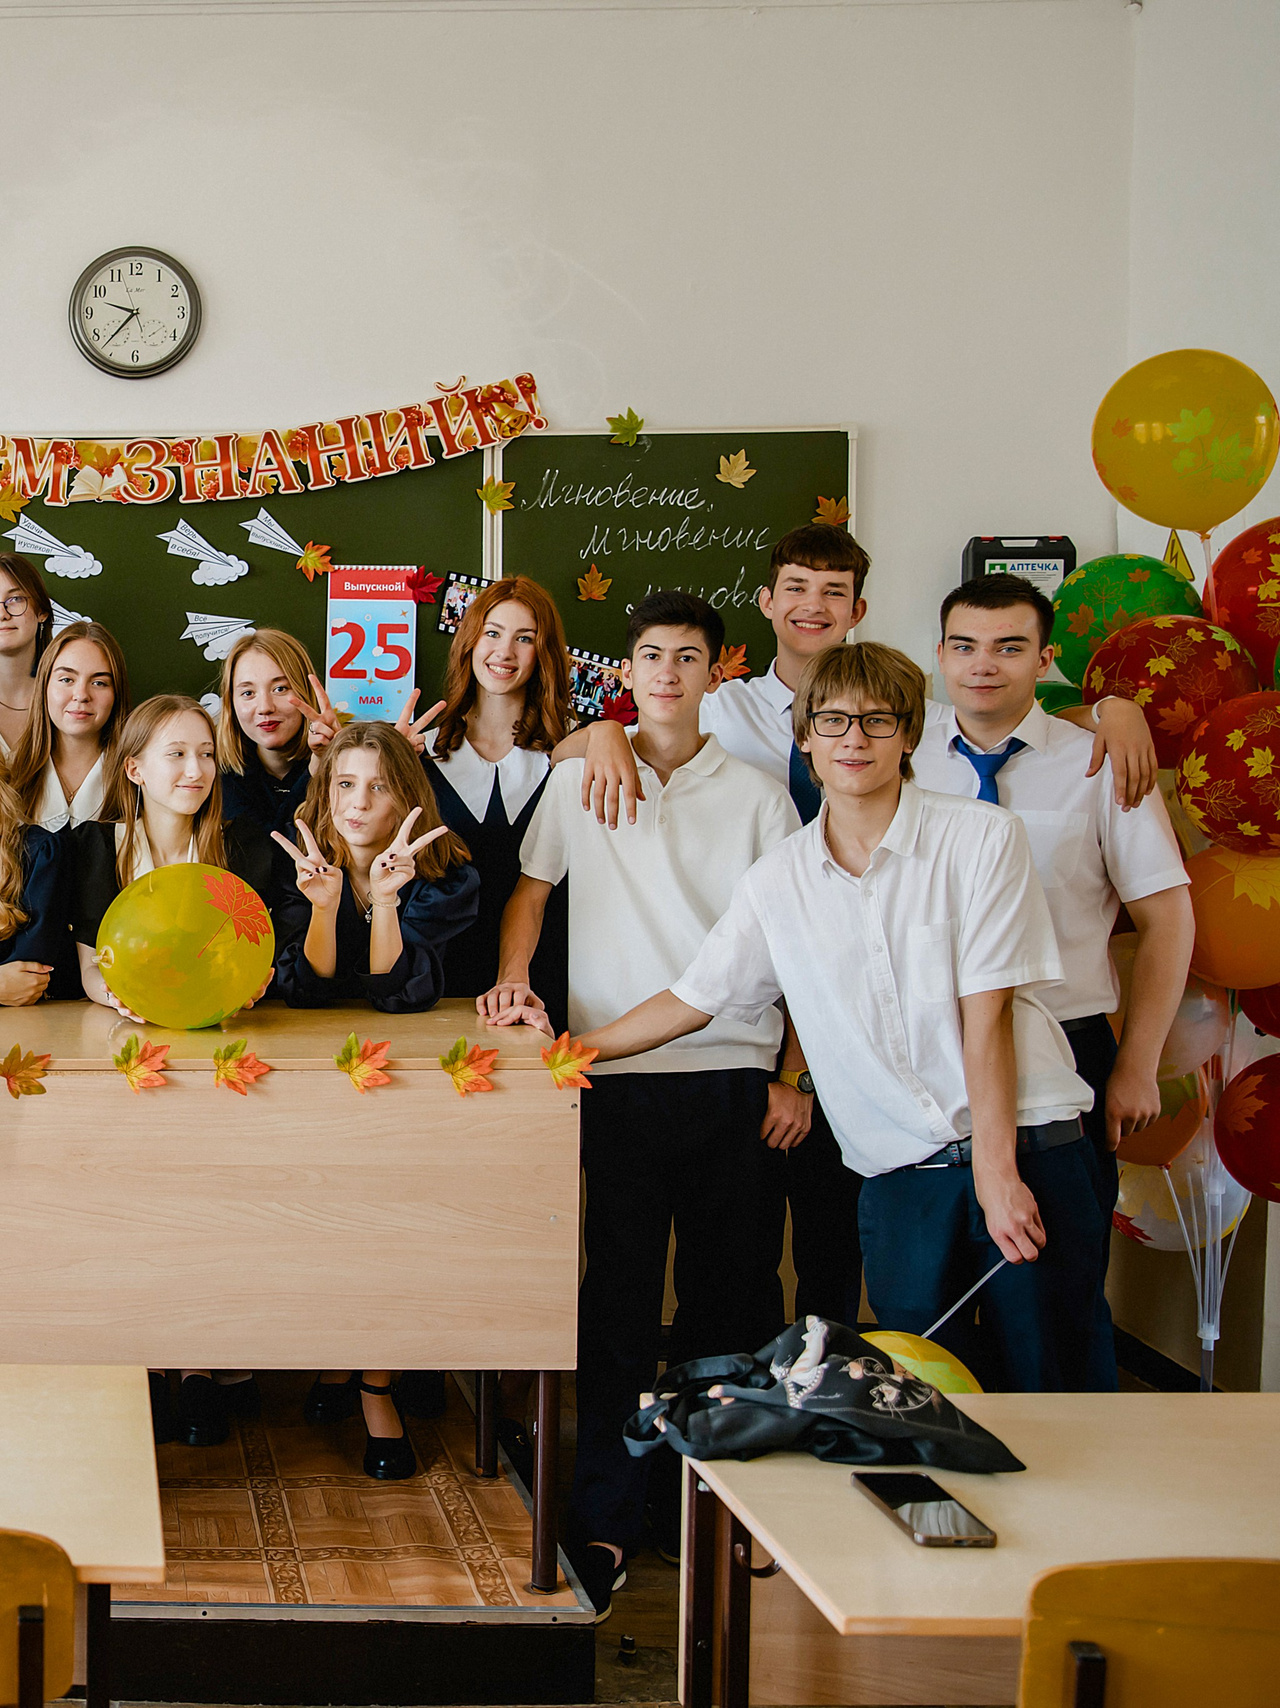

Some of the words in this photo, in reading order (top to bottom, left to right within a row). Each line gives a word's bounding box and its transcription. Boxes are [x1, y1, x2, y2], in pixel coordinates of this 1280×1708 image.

[128, 262, 143, 276] 12
[156, 269, 162, 282] 1
[109, 269, 122, 283] 11
[92, 285, 107, 298] 10
[170, 284, 179, 298] 2
[85, 306, 94, 319] 9
[177, 306, 186, 319] 3
[92, 328, 101, 341] 8
[169, 328, 178, 341] 4
[131, 350, 140, 363] 6
[120, 372, 549, 504] ЗНАНИЙ!
[22, 518, 44, 535] Удачи
[262, 515, 275, 528] Мы
[180, 524, 197, 539] Верь
[176, 546, 200, 557] себя!
[1009, 563, 1059, 571] АПТЕЧКА
[344, 581, 405, 593] Выпускной!
[194, 614, 208, 622] Все
[329, 622, 412, 680] 25
[358, 696, 383, 705] МАЯ
